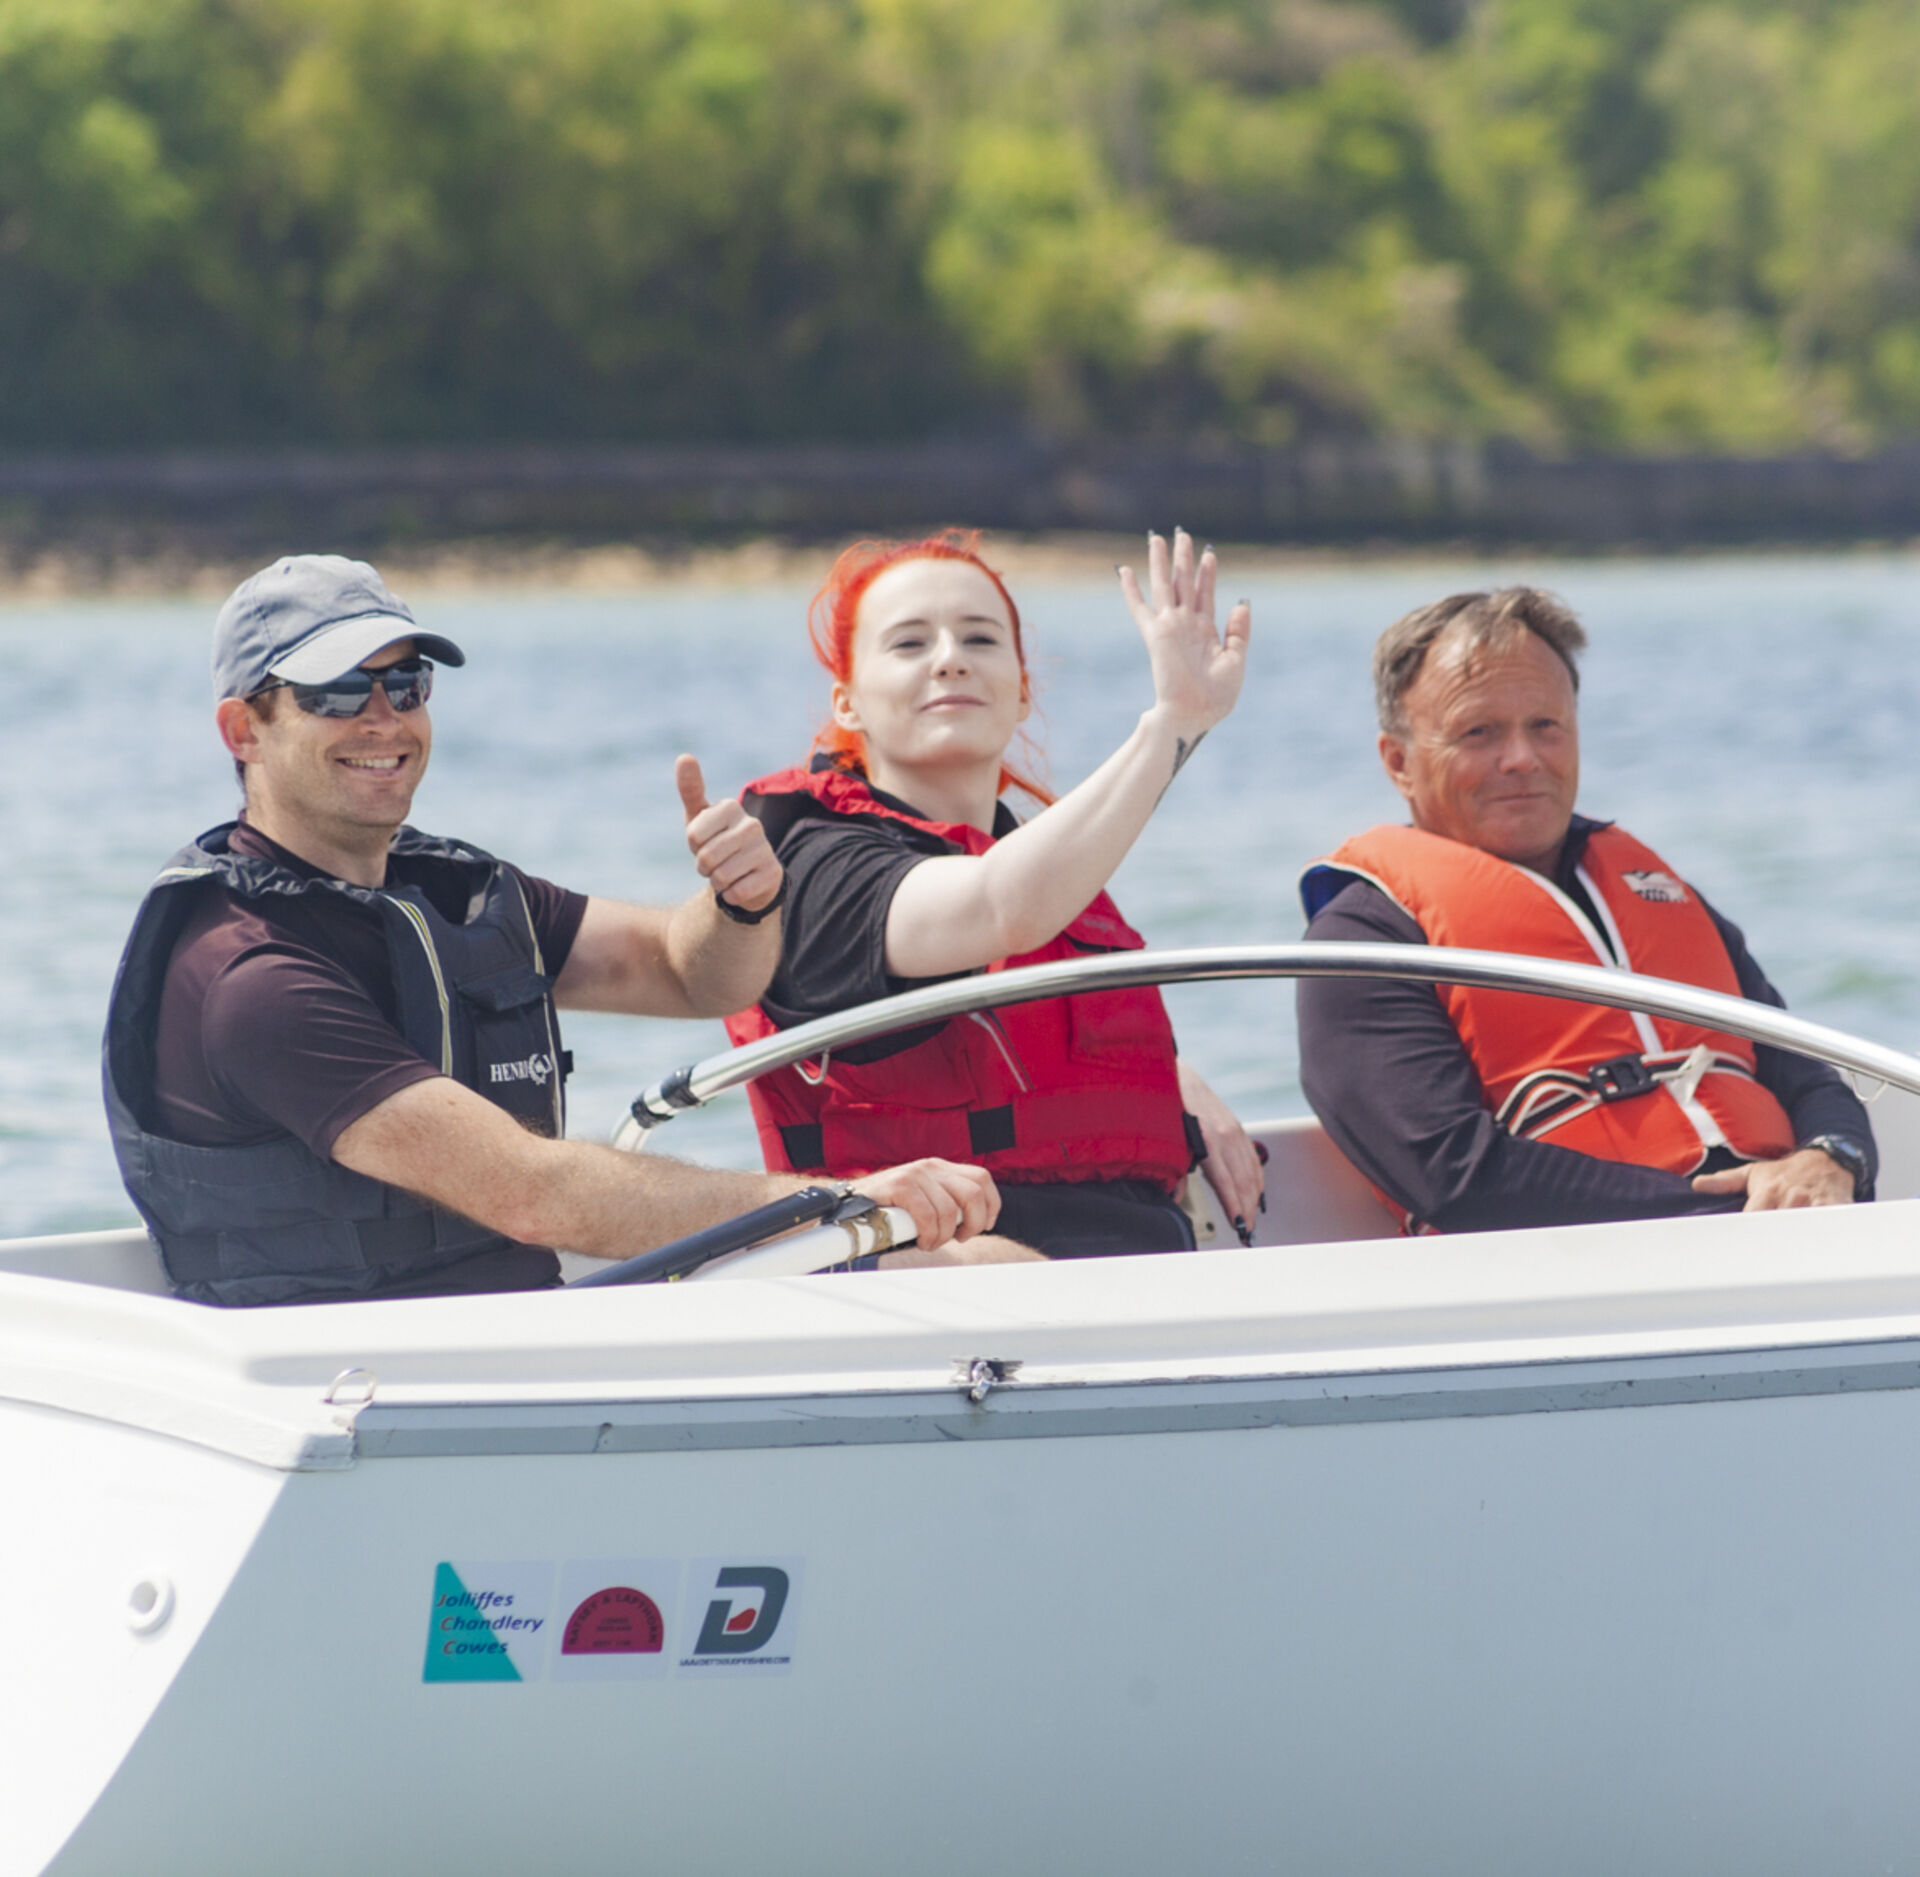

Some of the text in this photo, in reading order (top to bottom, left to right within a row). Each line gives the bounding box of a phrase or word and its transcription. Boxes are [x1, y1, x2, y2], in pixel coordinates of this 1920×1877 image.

[436, 1591, 514, 1610] Jolliffes
[440, 1615, 544, 1633] Chandlery
[442, 1640, 509, 1655] Cowes
